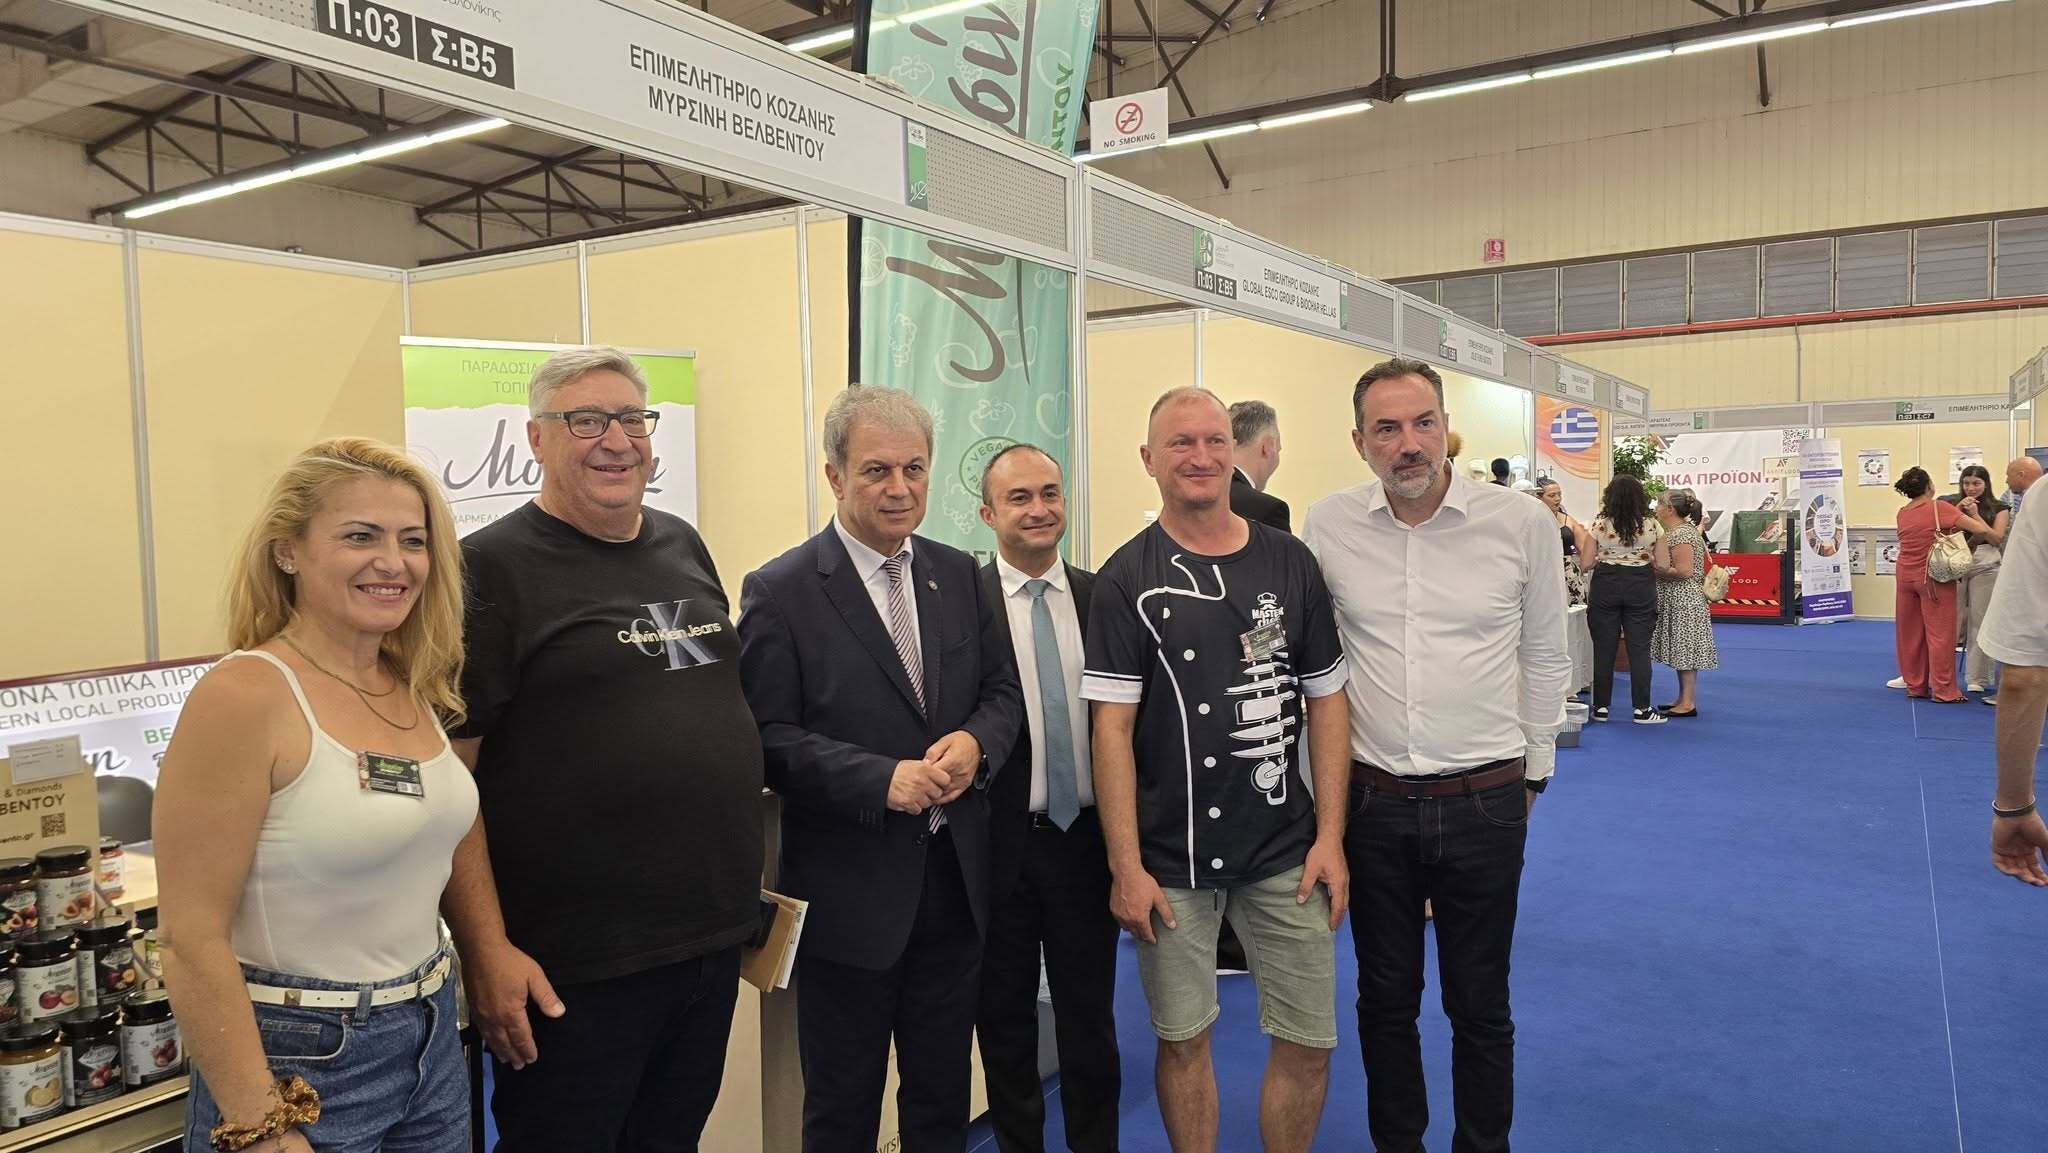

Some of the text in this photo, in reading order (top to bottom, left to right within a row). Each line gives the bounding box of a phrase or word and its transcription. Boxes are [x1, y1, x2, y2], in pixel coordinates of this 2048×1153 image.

[431, 28, 497, 78] Σ:Β5
[630, 44, 836, 137] ΕΠΙΜΕΛΗΤΗΡΙΟ ΚΟΖΑΝΗΣ
[648, 85, 824, 162] ΜΥΡΣΙΝΗ ΒΕΛΒΕΝΤΟΥ
[1103, 133, 1156, 149] NO SMOKING
[1242, 279, 1264, 297] GLOBAL
[1280, 290, 1296, 305] GROUP
[1320, 304, 1337, 318] HELLAS
[462, 359, 537, 374] ΠΑΡΑΔΟΣΙΑ
[492, 381, 529, 394] ΤΟΠΙ
[970, 442, 1010, 463] VEGA
[1664, 456, 1710, 465] LOOD
[617, 629, 660, 643] Calvin
[688, 622, 722, 638] Jeans
[0, 685, 58, 708] ΟΝΑ
[63, 673, 156, 700] ΤΟΠΙΚΑ
[0, 690, 191, 730] ERN LOCAL PRODU
[0, 793, 66, 816] ΒΕΝΤΟΥ
